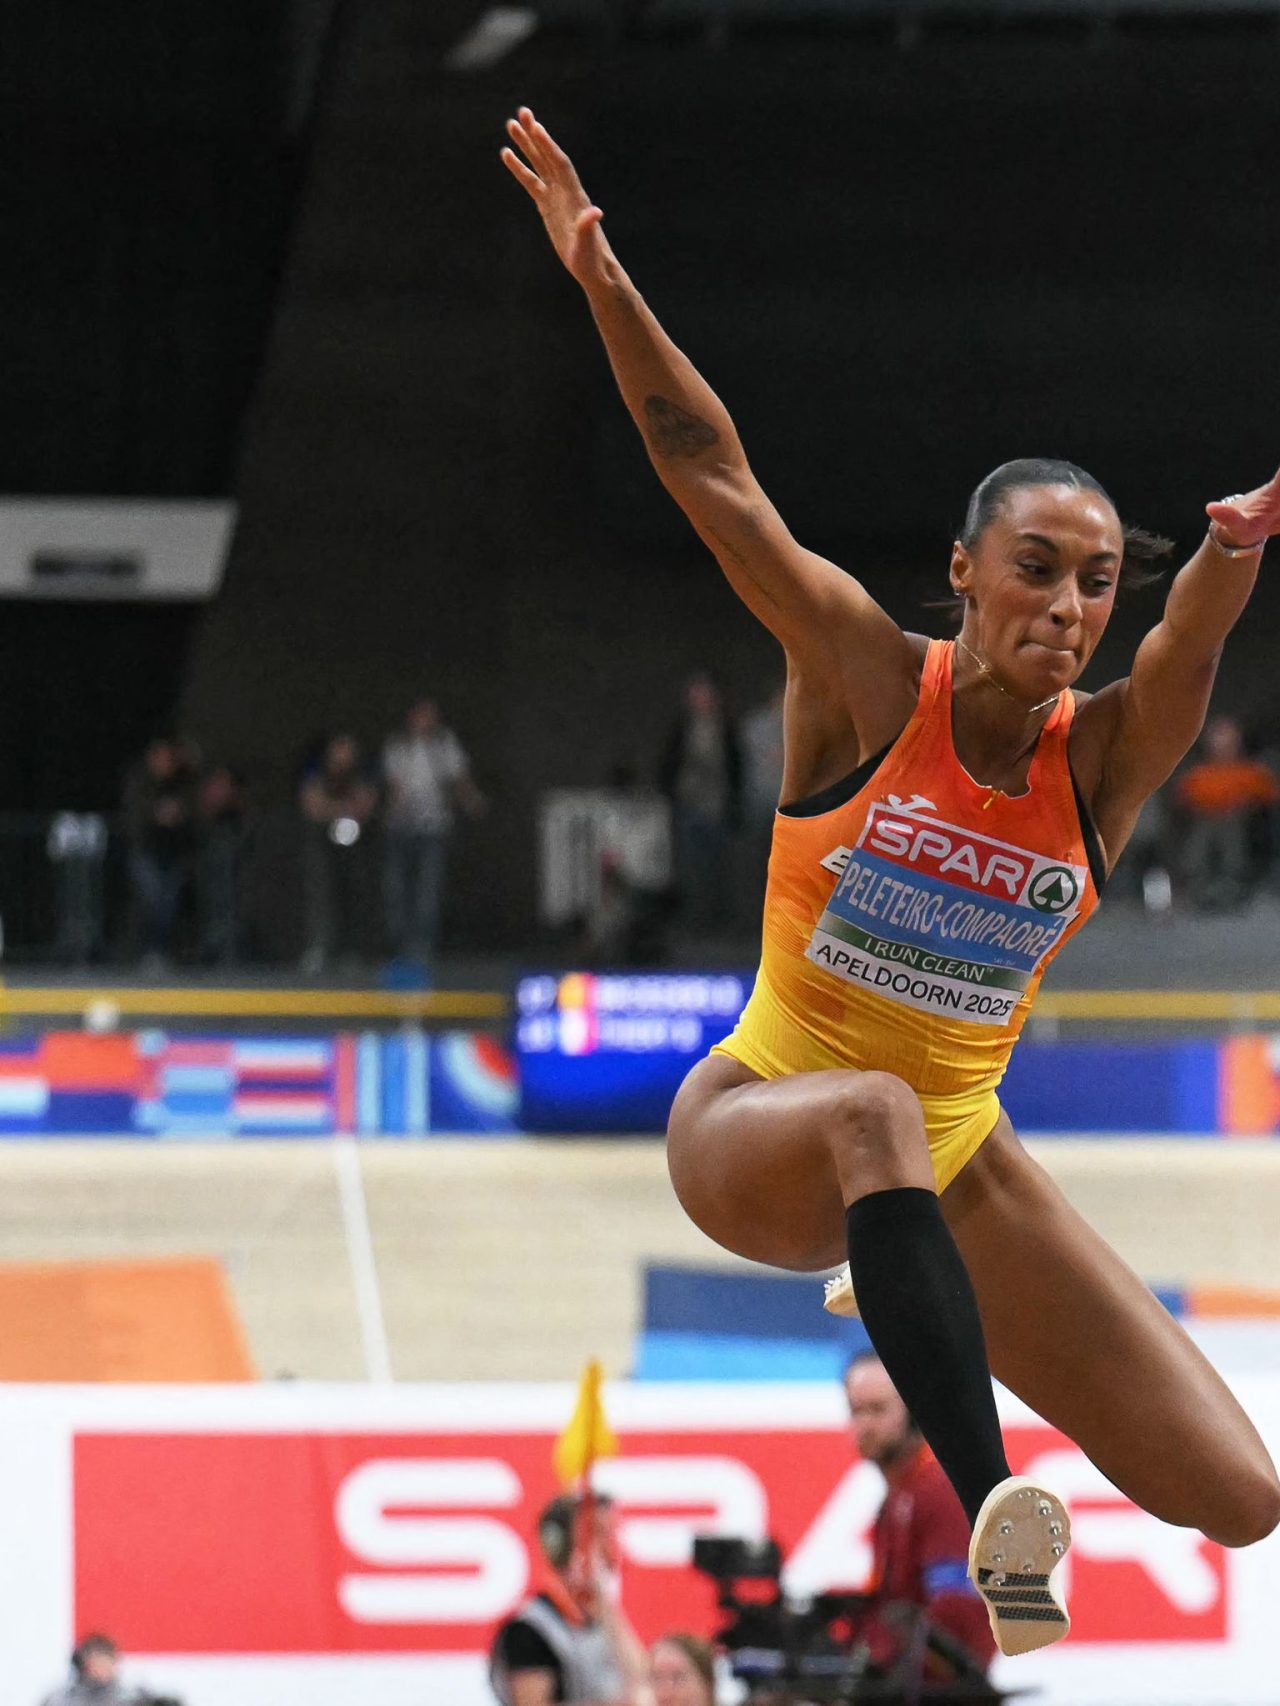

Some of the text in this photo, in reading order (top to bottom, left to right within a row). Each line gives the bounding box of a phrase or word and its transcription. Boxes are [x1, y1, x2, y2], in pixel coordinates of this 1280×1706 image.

[870, 820, 1025, 896] SPAR
[837, 861, 1062, 957] PELETEIRO-COMPAORÉ
[816, 943, 1014, 1017] APELDOORN 2025
[864, 937, 872, 950] I
[874, 941, 920, 966] RUN
